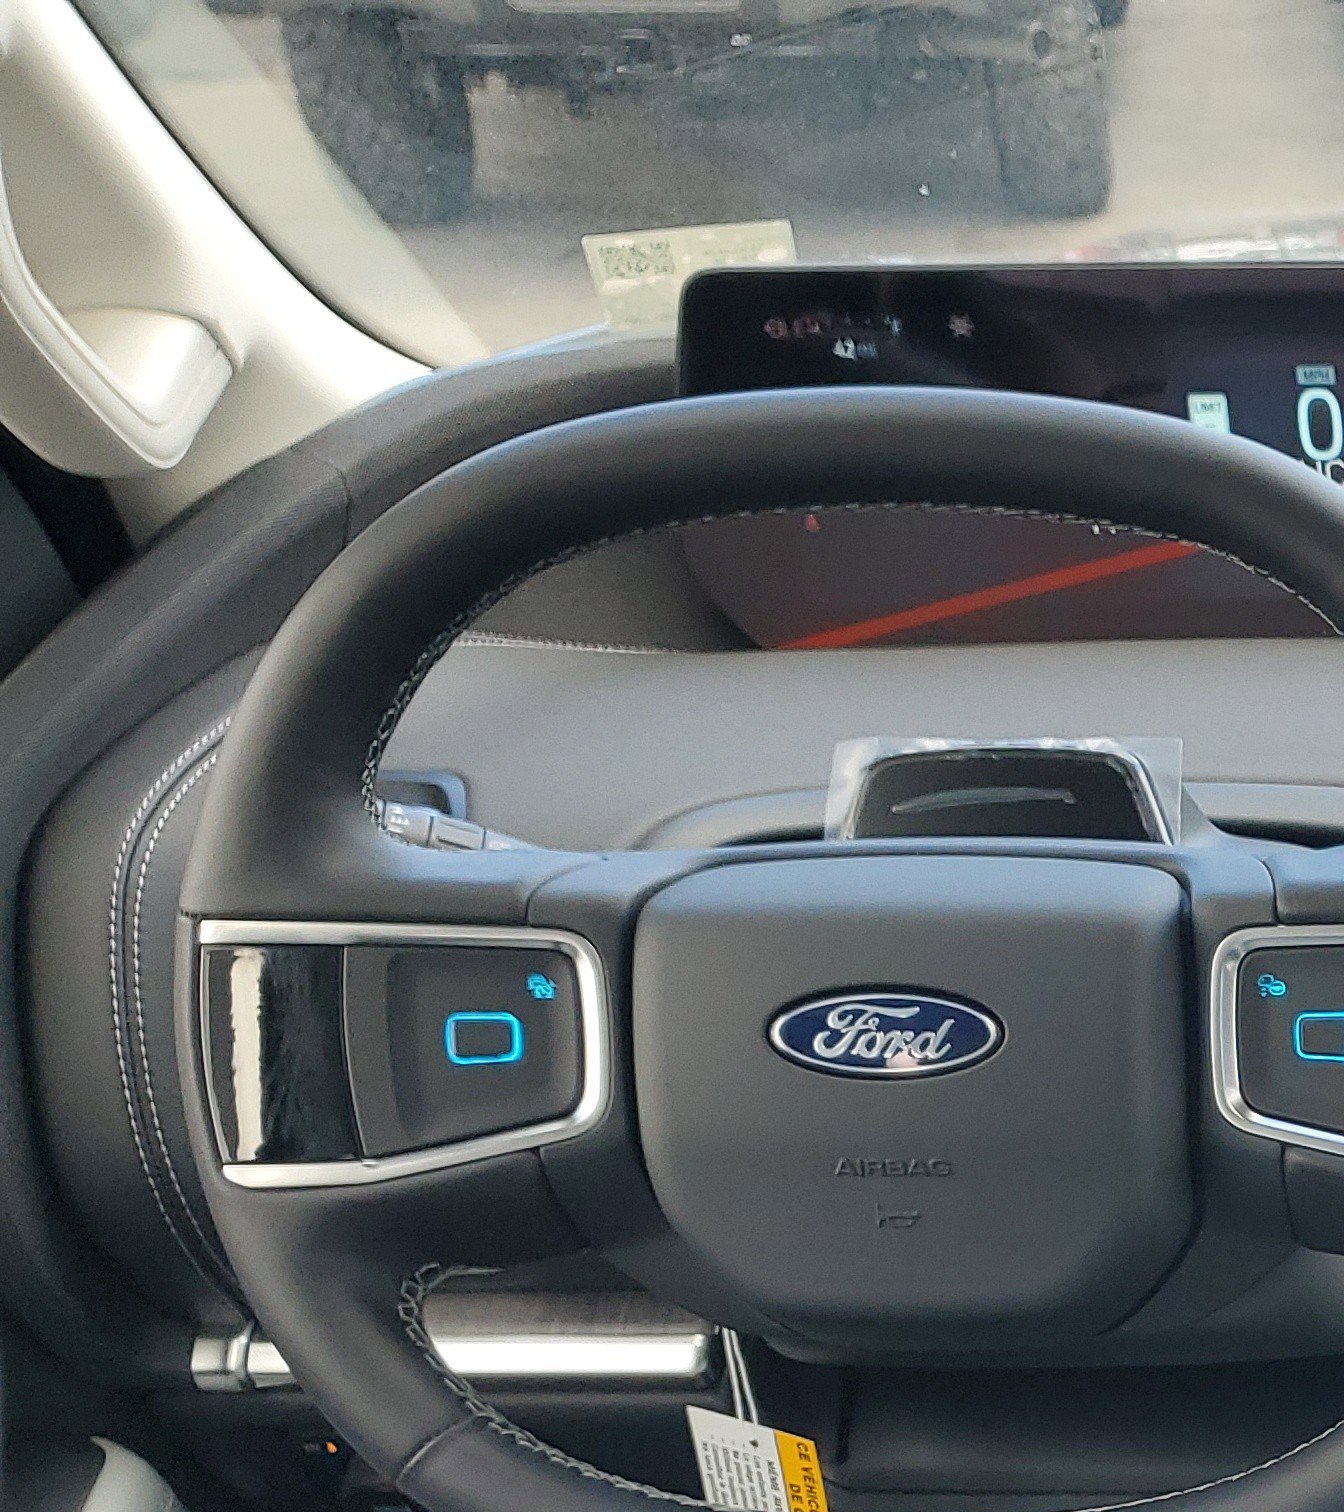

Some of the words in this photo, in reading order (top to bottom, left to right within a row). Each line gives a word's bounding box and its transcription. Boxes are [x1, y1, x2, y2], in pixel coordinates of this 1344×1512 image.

[1297, 387, 1344, 461] 0
[812, 1003, 955, 1059] Ford
[834, 1157, 953, 1178] AIRBAG
[796, 1442, 811, 1462] CE
[789, 1483, 803, 1504] DE
